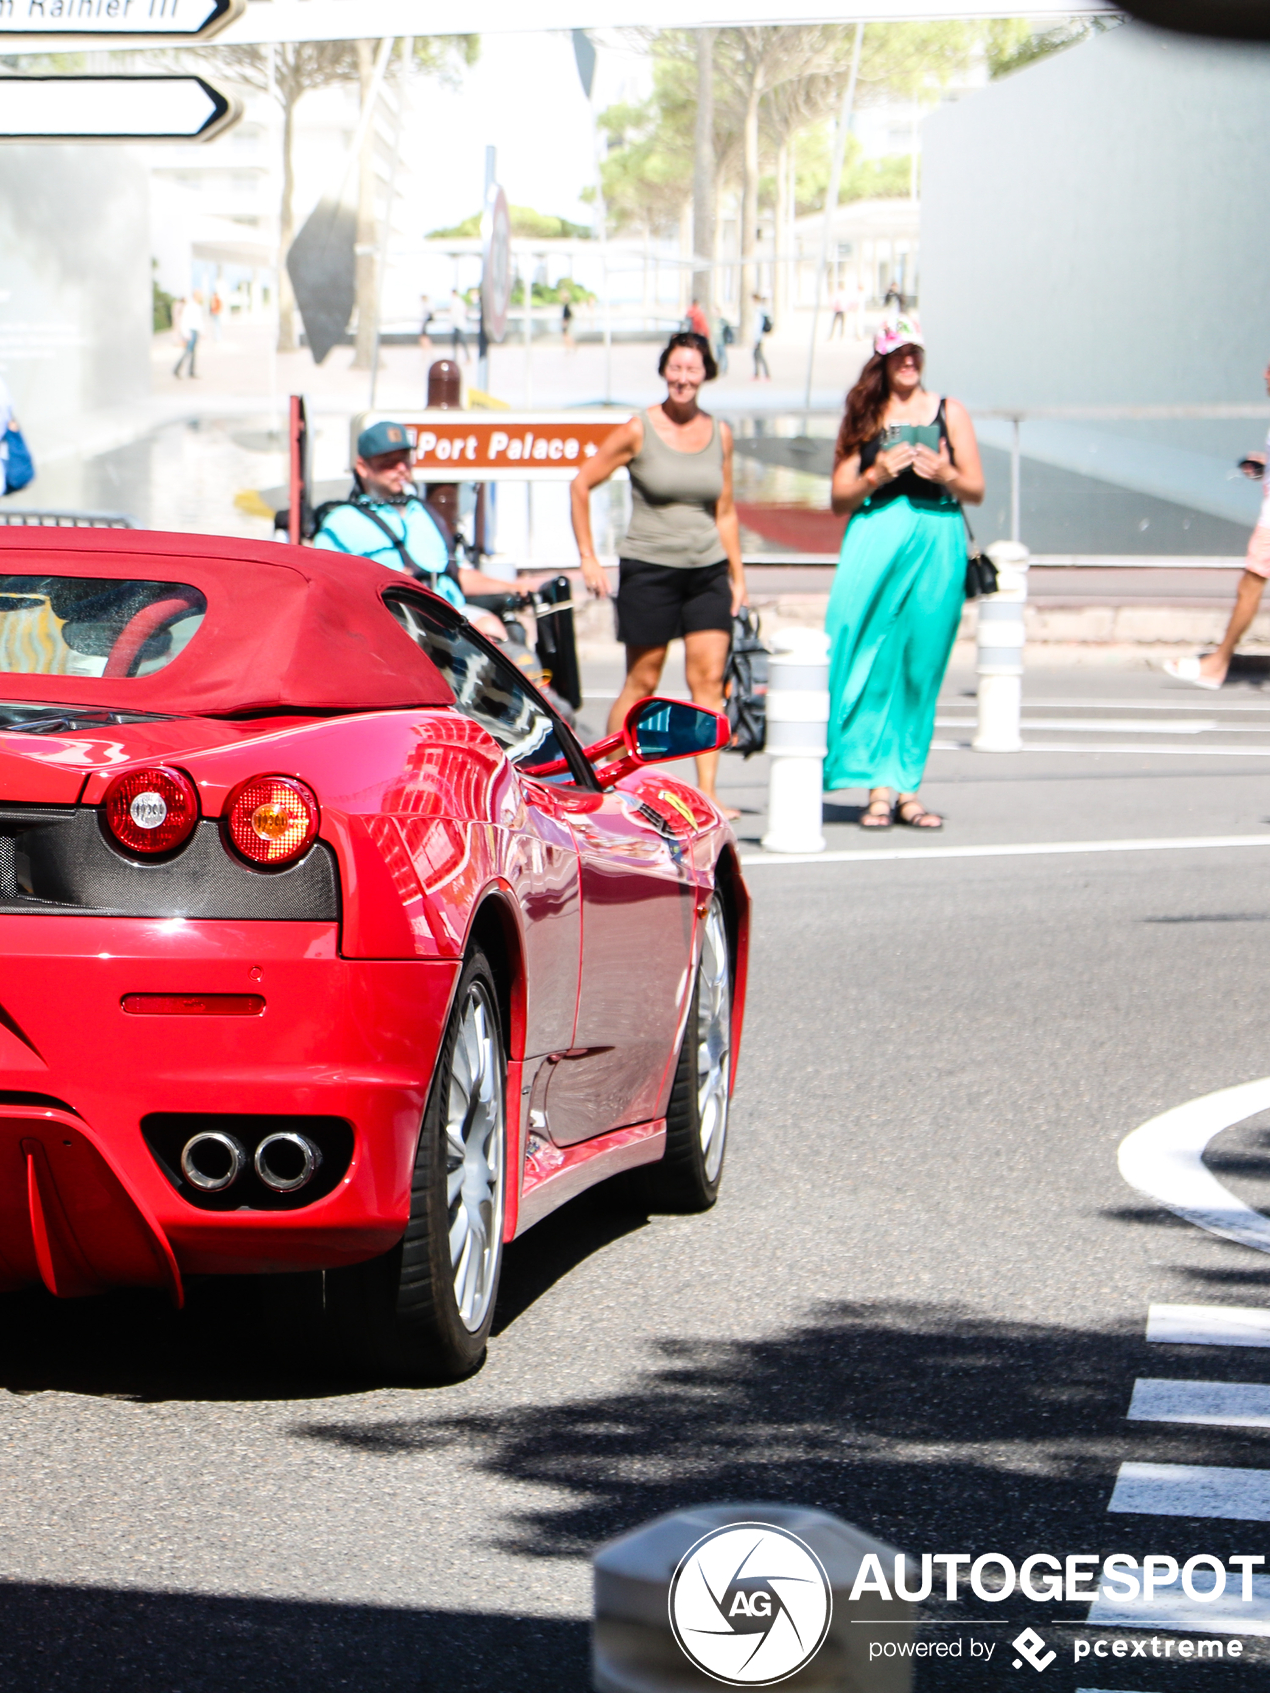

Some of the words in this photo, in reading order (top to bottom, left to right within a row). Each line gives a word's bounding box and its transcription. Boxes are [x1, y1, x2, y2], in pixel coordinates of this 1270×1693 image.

[27, 0, 130, 19] Rainier
[417, 431, 478, 460] Port
[487, 431, 580, 461] Palace
